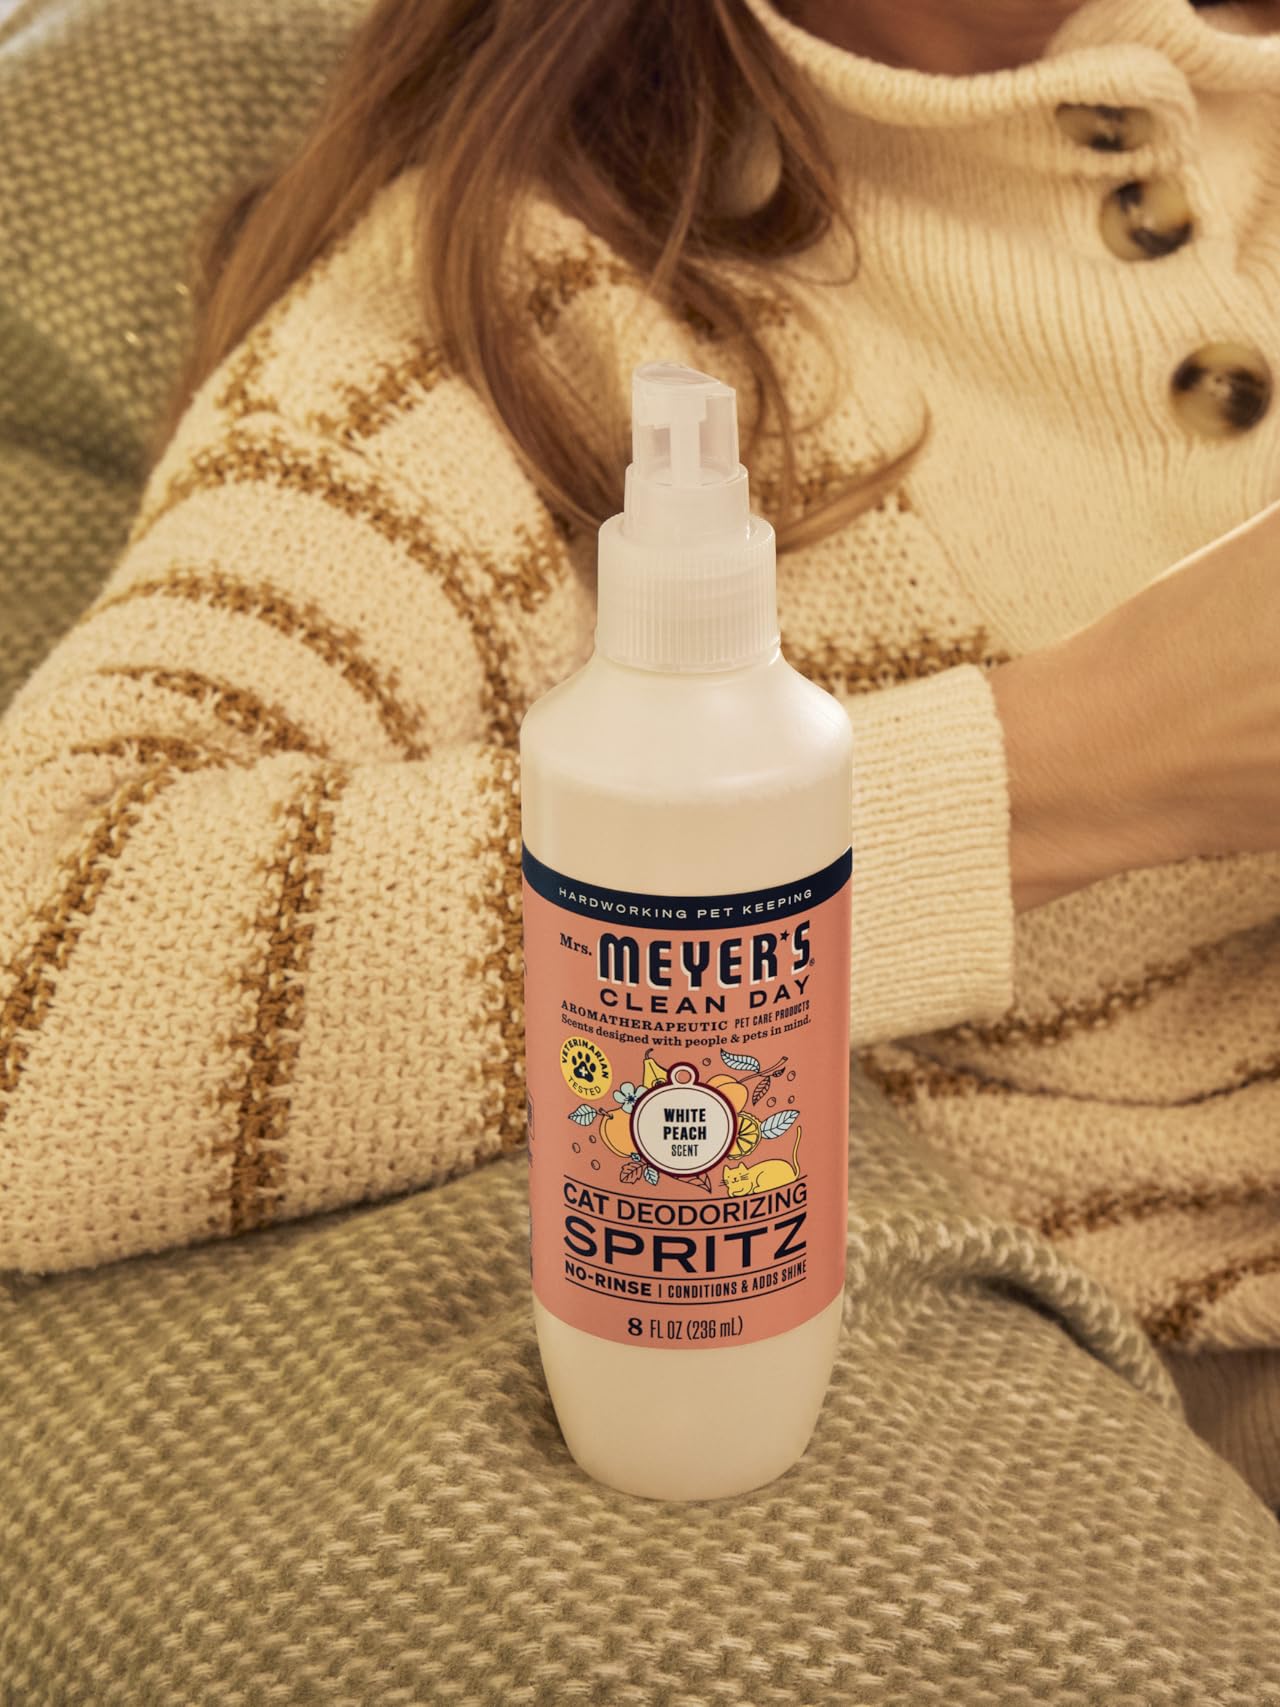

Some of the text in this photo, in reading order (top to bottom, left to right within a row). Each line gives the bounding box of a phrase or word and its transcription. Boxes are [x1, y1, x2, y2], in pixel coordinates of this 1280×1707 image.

[558, 887, 813, 919] HARDWORKING PET KEEPING
[559, 932, 592, 956] Mrs.
[600, 974, 810, 1015] CLEAN DAY
[561, 1000, 810, 1033] AROMATHERAPEUTIC PET CARE PRODUCTS
[561, 1013, 812, 1048] Scents designed with people & pets in mind.
[562, 1038, 609, 1079] VETERINARIAN
[568, 1076, 602, 1096] TESTED
[663, 1108, 706, 1123] WHITE
[663, 1126, 707, 1141] PEACH
[671, 1144, 699, 1157] SCENT
[563, 1182, 807, 1226] CAT DEODORIZING
[563, 1211, 807, 1274] SPRITZ
[565, 1260, 807, 1298] NO-RINSE CONDITIONS & ADDS SHINE
[627, 1316, 743, 1341] 8 FL OZ (236 mL)
